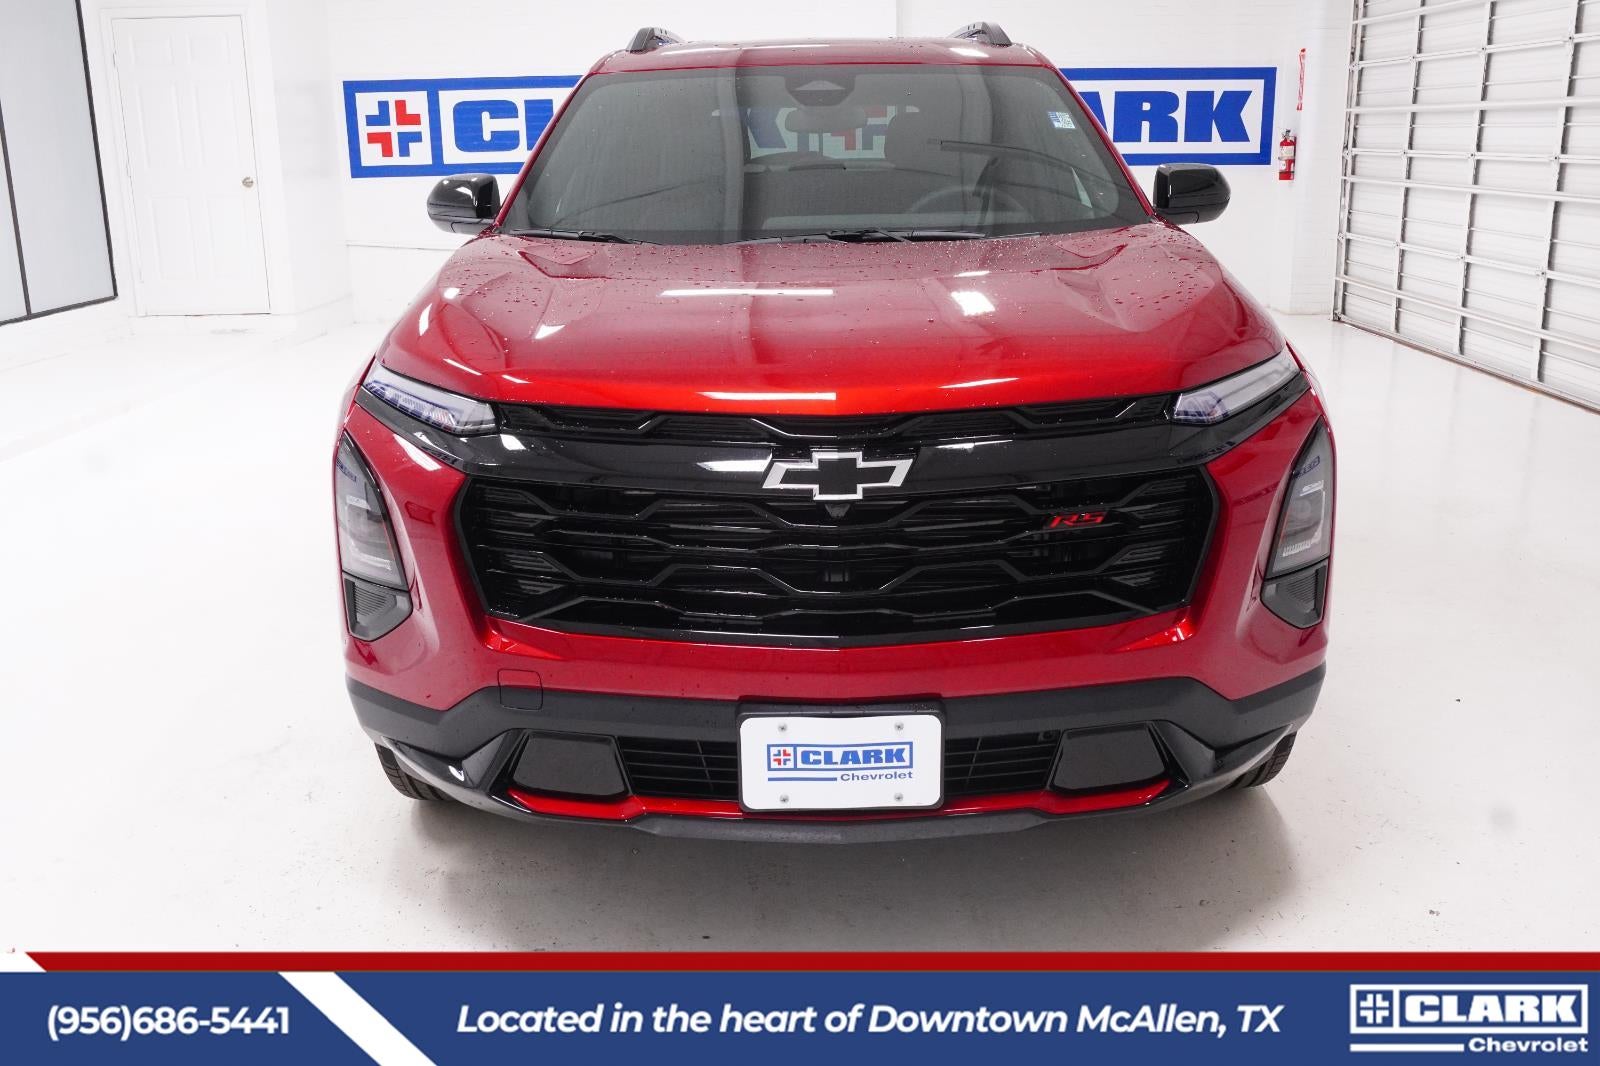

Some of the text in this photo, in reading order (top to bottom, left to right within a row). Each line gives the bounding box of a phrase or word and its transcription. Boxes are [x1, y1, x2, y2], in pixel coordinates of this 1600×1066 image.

[1080, 91, 1252, 142] RK
[1049, 512, 1105, 528] RS
[800, 747, 907, 766] CLARK
[840, 771, 914, 782] Chevrolet
